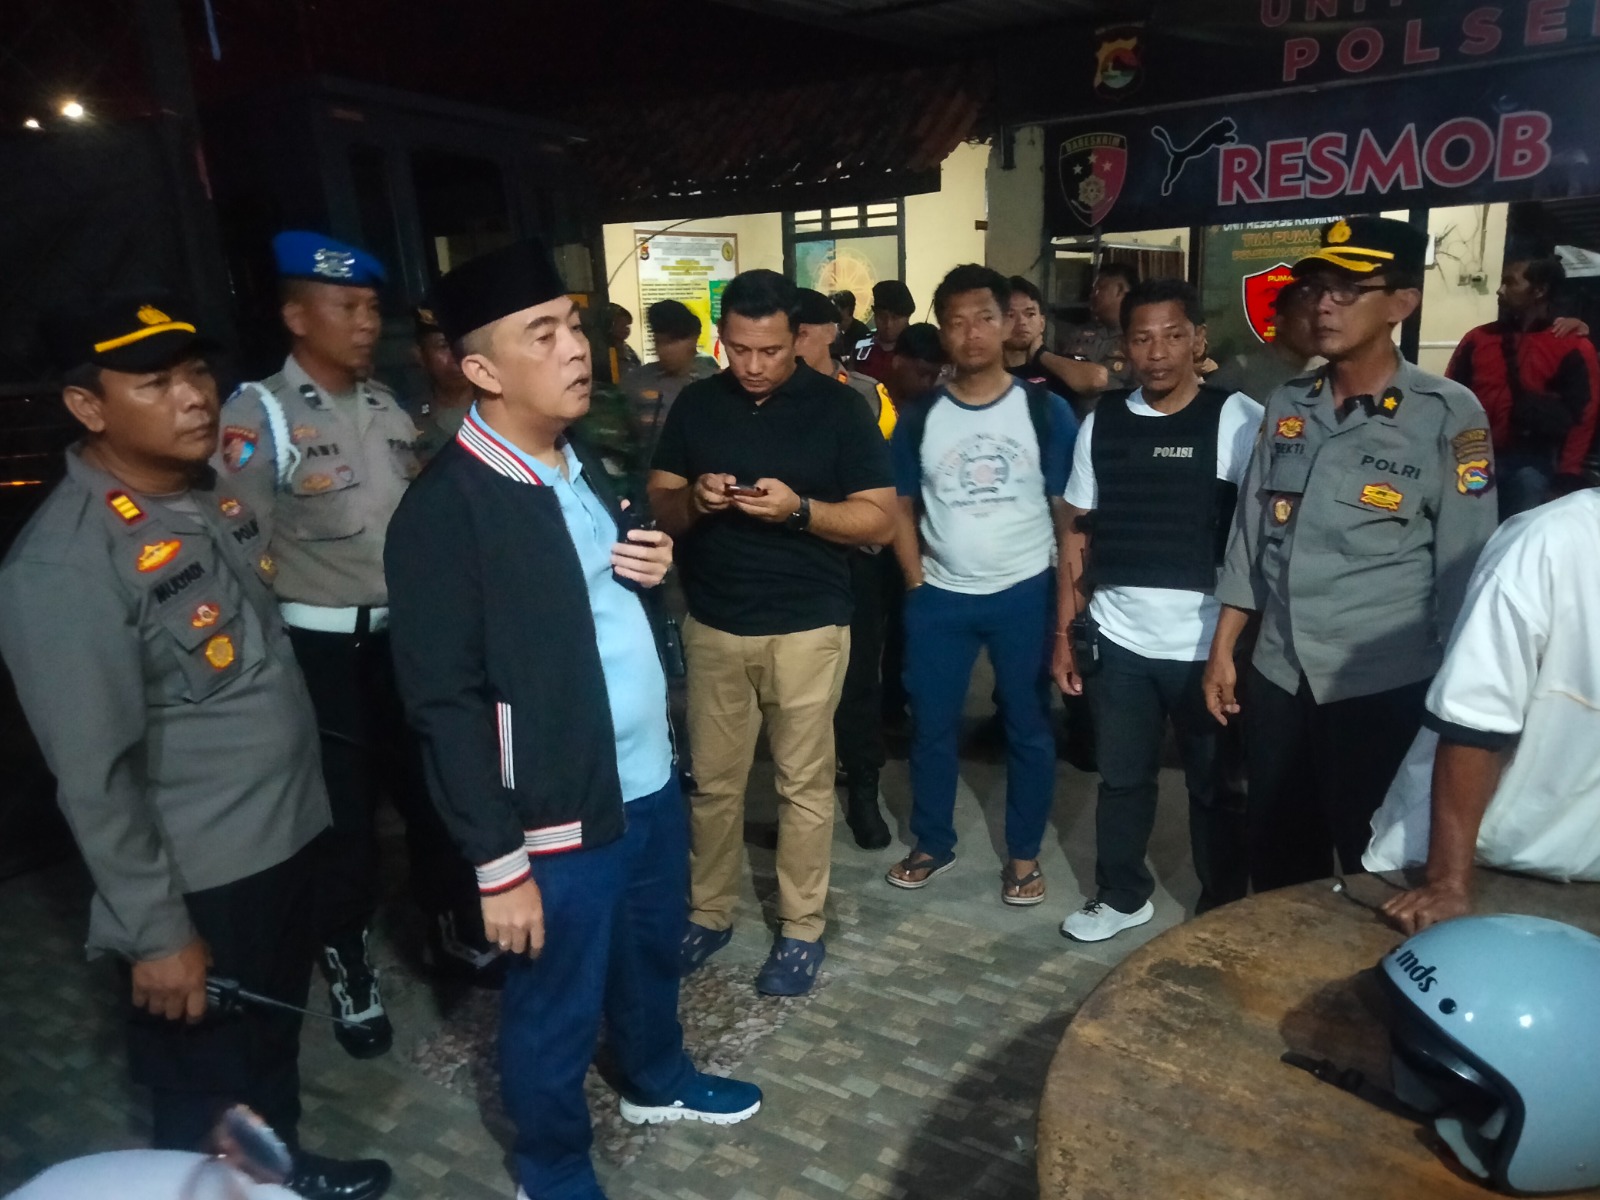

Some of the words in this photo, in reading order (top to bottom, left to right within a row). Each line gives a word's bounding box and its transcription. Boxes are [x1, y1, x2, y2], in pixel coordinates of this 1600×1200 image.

[1282, 0, 1600, 82] POLSE
[1218, 110, 1552, 206] RESMOB
[1243, 232, 1270, 247] TIM
[1272, 228, 1321, 245] PUMA
[1152, 446, 1194, 458] POLISI
[1360, 455, 1421, 480] POLRI
